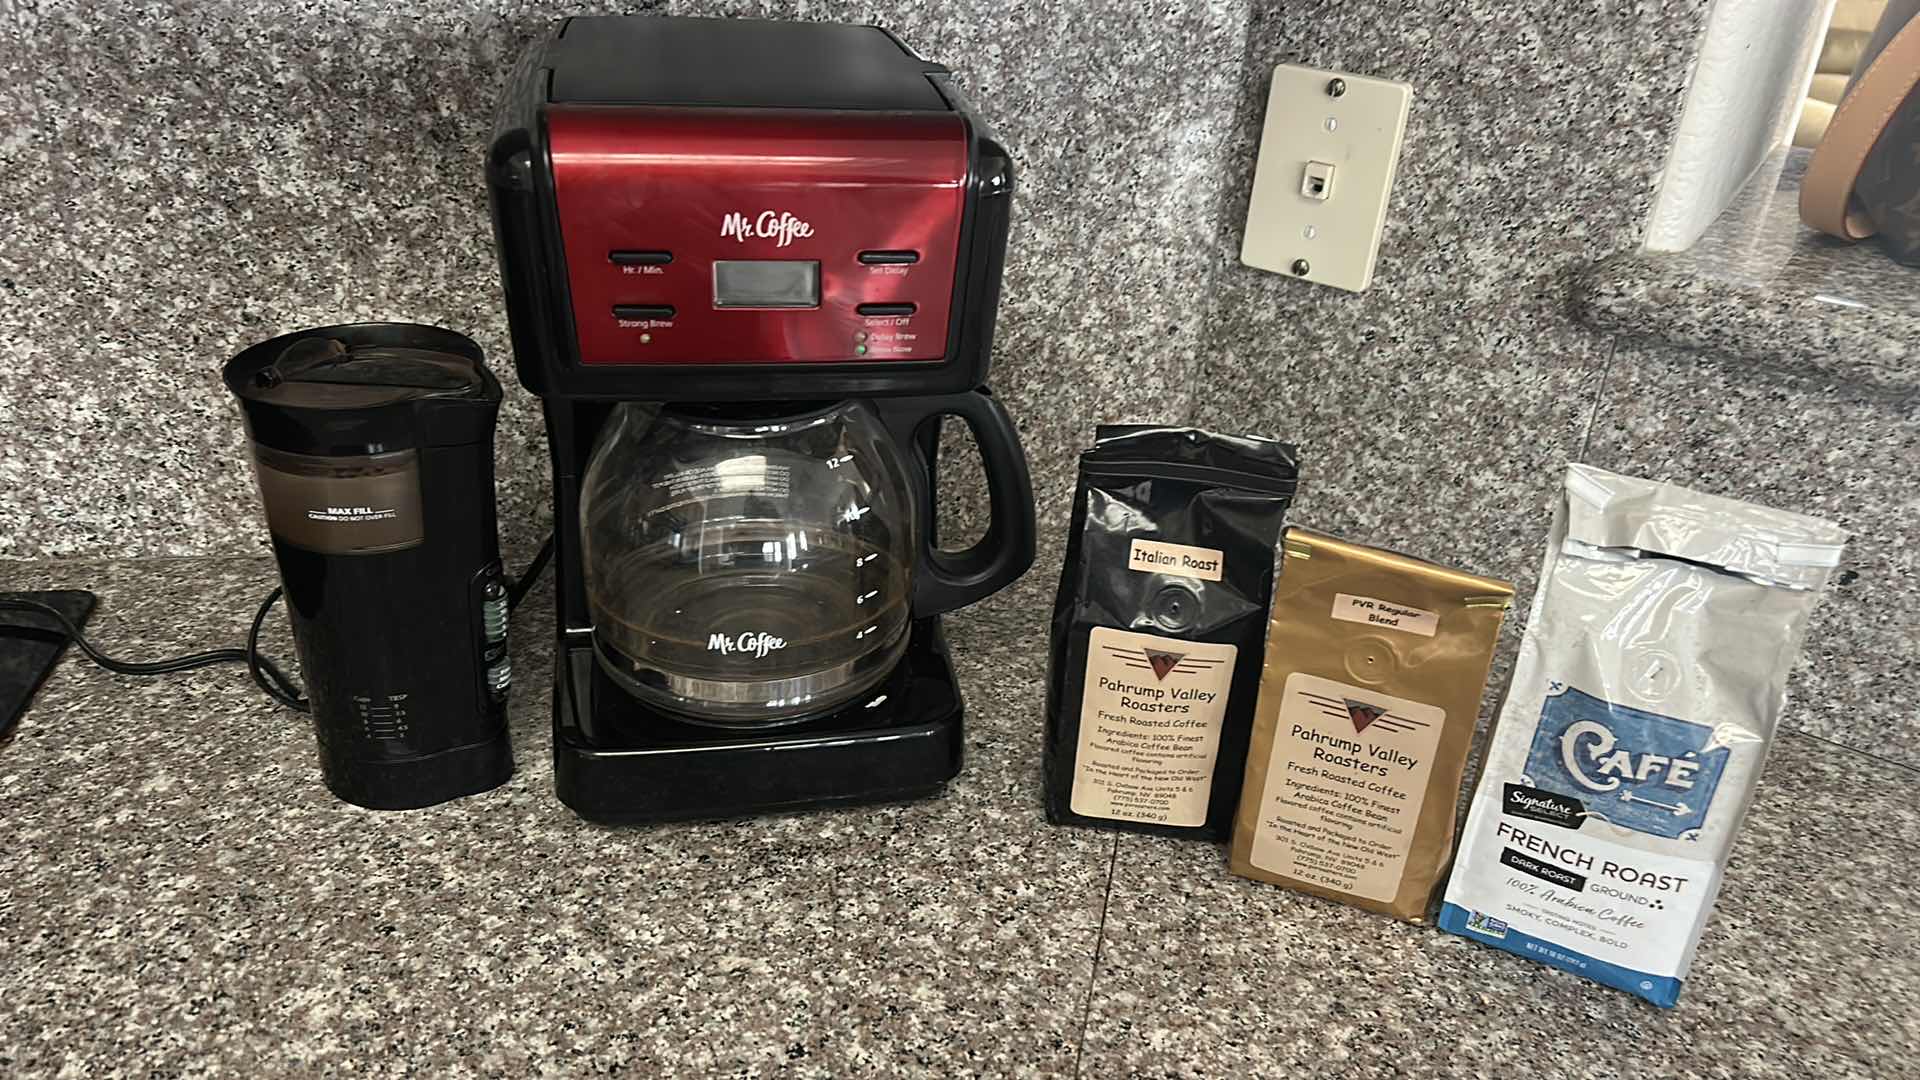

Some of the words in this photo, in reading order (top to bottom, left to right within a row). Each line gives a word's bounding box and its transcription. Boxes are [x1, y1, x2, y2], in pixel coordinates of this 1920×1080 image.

[720, 212, 755, 243] Mr.
[755, 210, 815, 248] Coffee
[618, 319, 649, 330] Strong
[649, 319, 674, 328] Brew
[895, 317, 910, 327] Off
[825, 458, 841, 470] 12
[327, 506, 353, 516] MAX
[353, 506, 374, 515] FILL
[855, 557, 864, 568] 8
[1133, 548, 1177, 567] Italian
[1182, 554, 1220, 572] Roast
[856, 594, 864, 605] 6
[1351, 599, 1374, 609] PVR
[1378, 603, 1421, 618] Regular
[1367, 613, 1400, 626] Blend
[855, 630, 864, 640] 4
[707, 634, 736, 655] Mr.
[737, 632, 787, 658] Coffee
[1098, 676, 1165, 701] Pahrump
[1170, 687, 1217, 704] Valley
[1120, 696, 1190, 714] Roasters
[1097, 710, 1127, 723] Fresh
[1129, 716, 1170, 728] Roasted
[1172, 719, 1209, 728] Coffee
[1097, 725, 1148, 741] Ingredients:
[1152, 734, 1176, 742] 100%
[1177, 735, 1204, 743] Finest
[1106, 738, 1139, 749] Arabica
[1140, 742, 1171, 751] Coffee
[1172, 743, 1194, 751] Bean
[1291, 724, 1362, 756] Pahrump
[1368, 743, 1418, 771] Valley
[1312, 746, 1389, 777] Roasters
[1558, 719, 1700, 793] CAFÉ
[1287, 761, 1319, 777] Fresh
[1320, 769, 1365, 789] Roasted
[1367, 782, 1408, 800] Coffee
[1285, 778, 1342, 798] Ingredients:
[1344, 792, 1369, 806] 100%
[1370, 799, 1401, 815] Finest
[1509, 790, 1572, 814] Signature
[1111, 808, 1121, 816] 12
[1293, 791, 1330, 805] Arabica
[1330, 799, 1363, 815] Coffee
[1364, 809, 1388, 822] Bean
[1496, 821, 1595, 871] FRENCH
[1600, 860, 1689, 893] ROAST
[1293, 868, 1304, 876] 12
[1510, 855, 1541, 872] DARK
[1540, 866, 1577, 885] ROAST
[1506, 876, 1538, 895] 100%
[1598, 908, 1646, 929] Coffee
[1589, 883, 1649, 906] GROUND
[1599, 935, 1629, 949] BOLD
